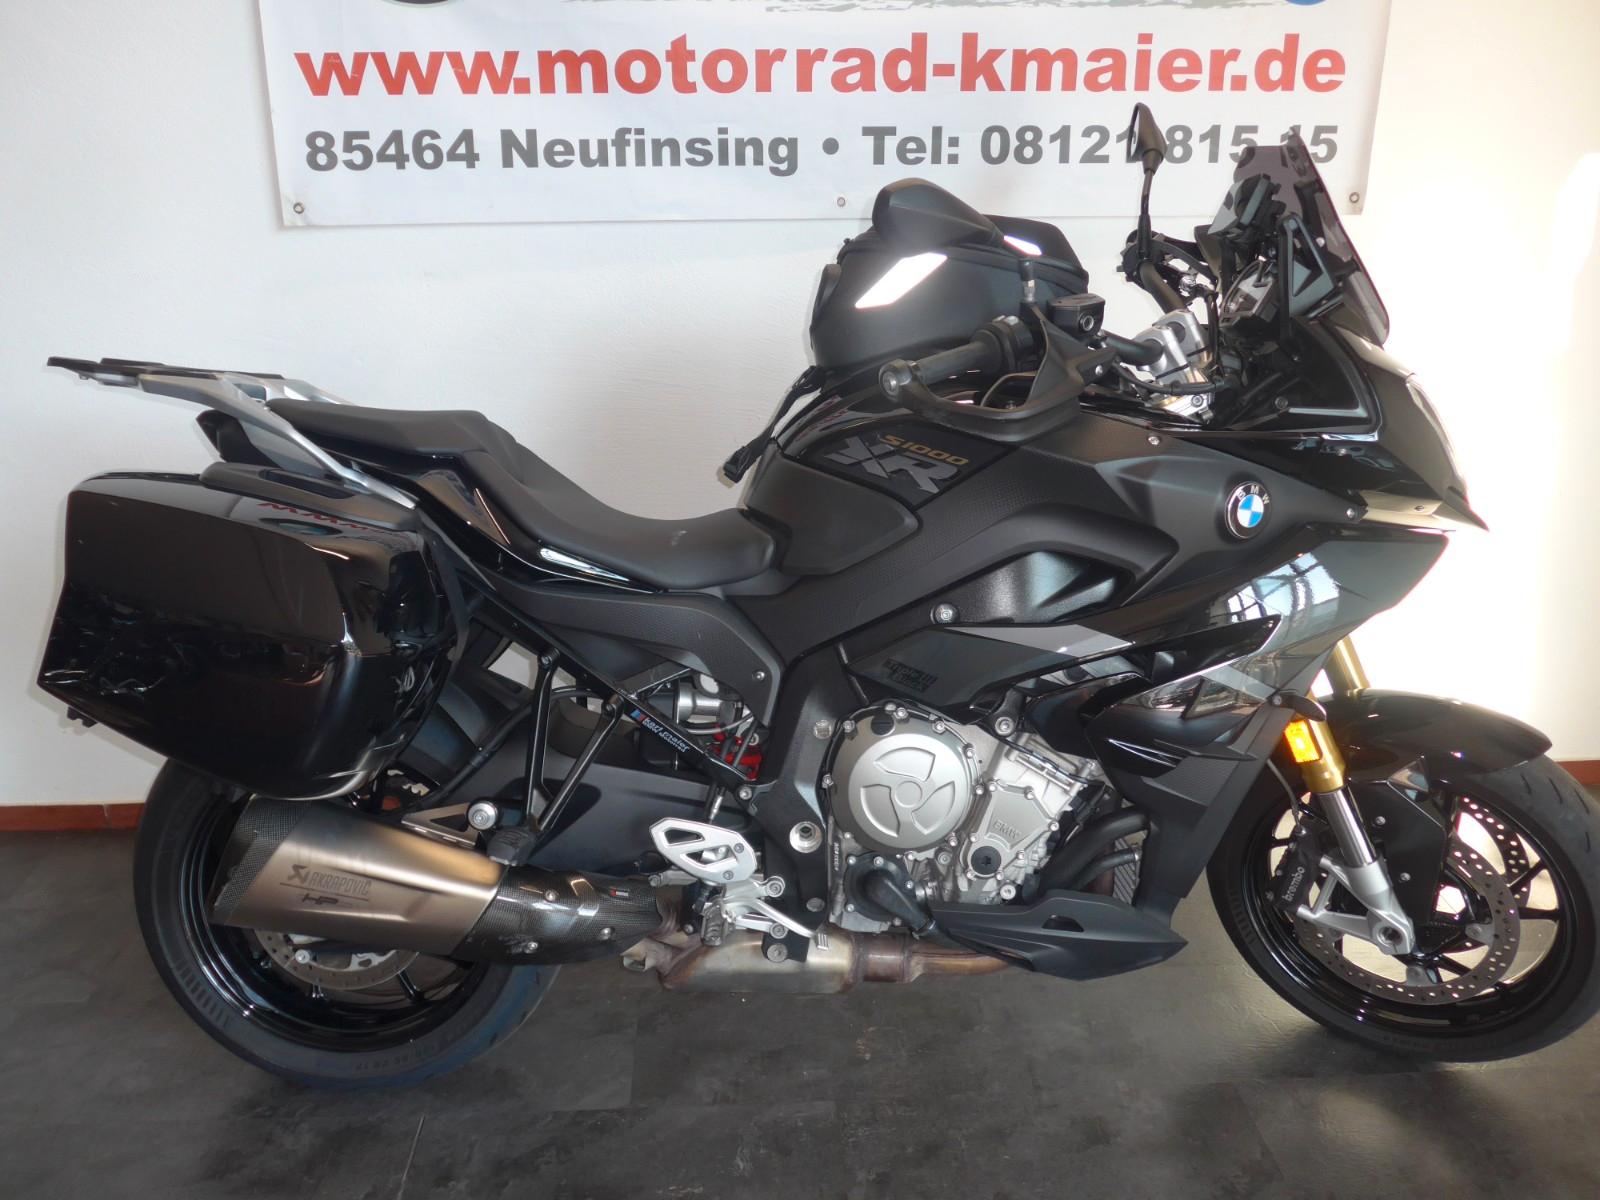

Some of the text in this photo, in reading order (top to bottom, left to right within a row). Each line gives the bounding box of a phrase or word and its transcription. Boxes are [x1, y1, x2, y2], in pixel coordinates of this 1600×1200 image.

[294, 33, 1346, 97] www.motorrad-kmaier.de
[305, 129, 480, 172] 85464
[500, 127, 799, 177] Neufinsing
[861, 126, 960, 166] Tel:
[824, 436, 958, 494] XR
[880, 434, 969, 465] S1000
[1282, 866, 1305, 902] brembo
